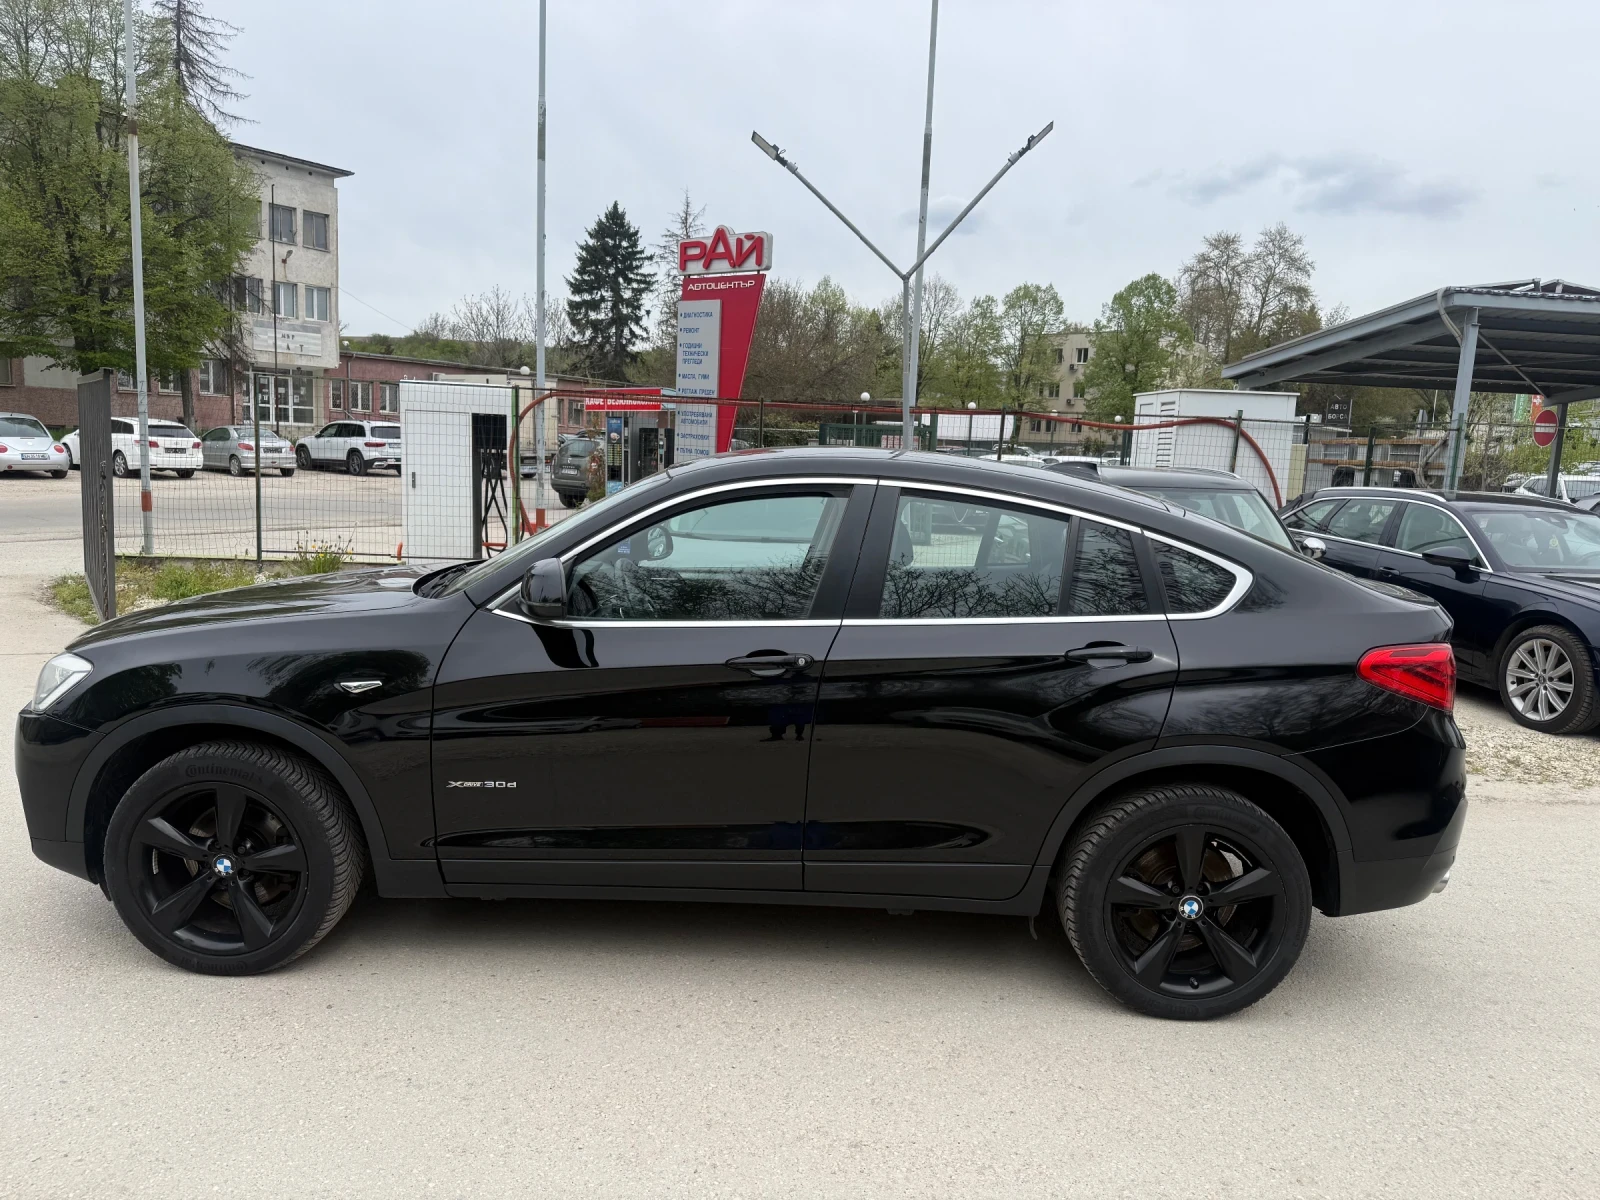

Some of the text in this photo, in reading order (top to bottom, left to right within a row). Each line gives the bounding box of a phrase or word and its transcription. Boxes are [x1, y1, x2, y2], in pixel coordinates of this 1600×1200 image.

[679, 227, 763, 271] РАЙ
[687, 280, 755, 291] АВТОЦЕНТЪР
[185, 762, 255, 782] Continental
